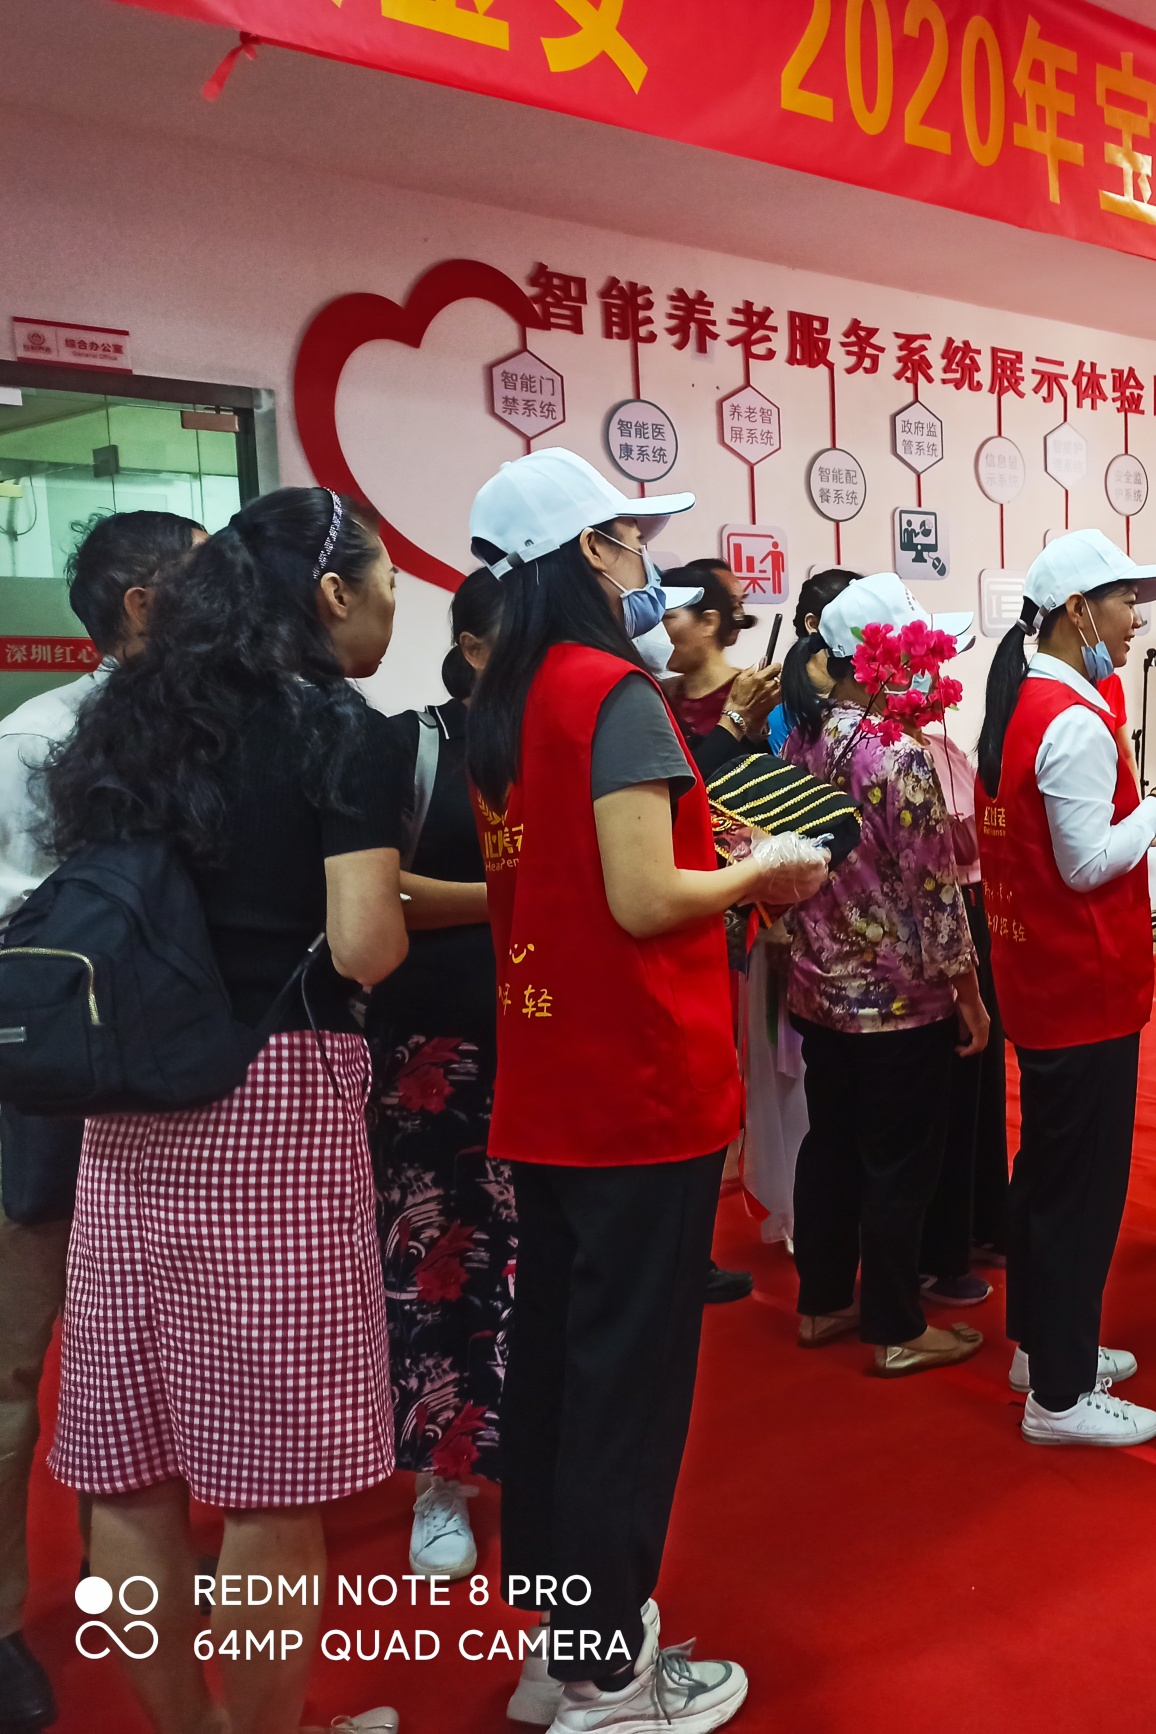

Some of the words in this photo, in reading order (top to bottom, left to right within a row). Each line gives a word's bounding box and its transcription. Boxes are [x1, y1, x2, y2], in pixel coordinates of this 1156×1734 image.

[64, 338, 124, 355] 综合办公室
[500, 369, 556, 397] 智能门
[501, 396, 557, 422] 禁系统
[729, 403, 773, 425] 养老智
[616, 418, 667, 442] 智能医
[729, 425, 774, 448] 屏系统
[901, 419, 938, 439] 政府监
[617, 442, 668, 465] 康系统
[901, 439, 939, 459] 管系统
[817, 465, 859, 486] 智能配
[818, 487, 859, 507] 餐系统
[5, 643, 99, 664] 深圳红心
